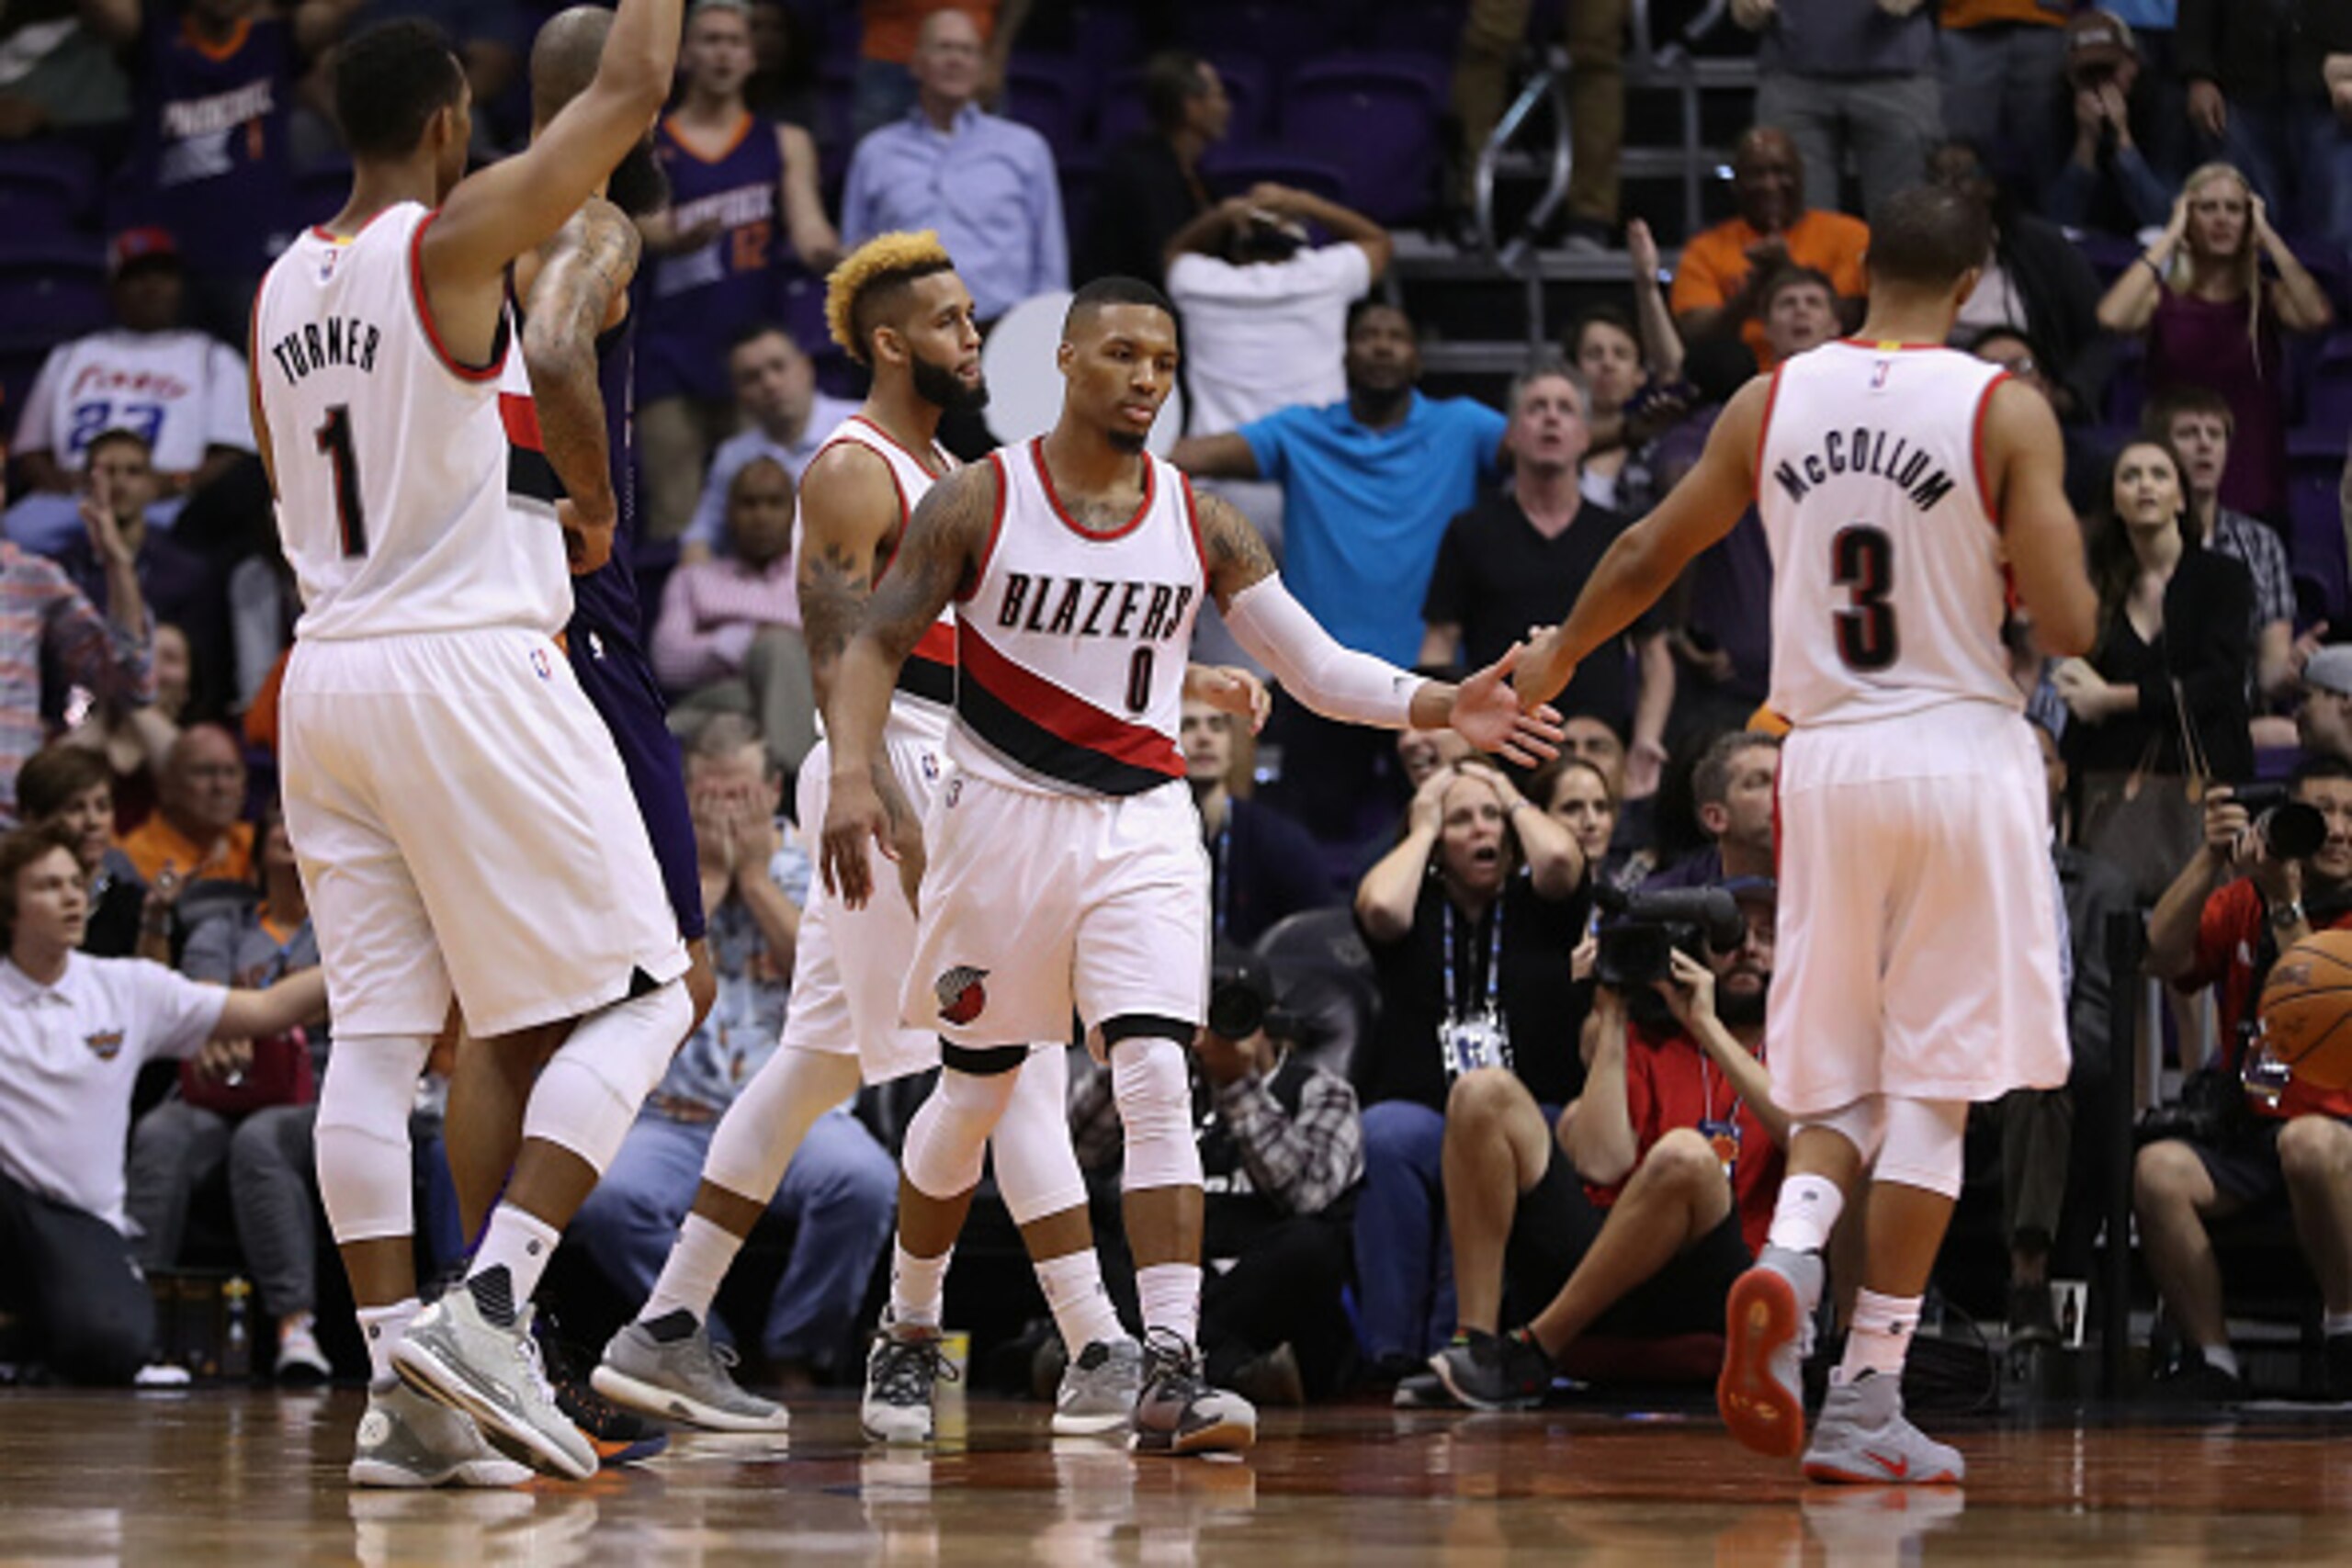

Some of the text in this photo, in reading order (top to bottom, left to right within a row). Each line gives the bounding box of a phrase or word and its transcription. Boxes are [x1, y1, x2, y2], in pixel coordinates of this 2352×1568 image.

[273, 316, 380, 386] TURNER
[314, 403, 368, 559] 1
[1774, 427, 1955, 512] McCOLLUM
[997, 573, 1193, 640] BLAZERS
[1831, 524, 1901, 673] 3
[1125, 645, 1154, 714] 0
